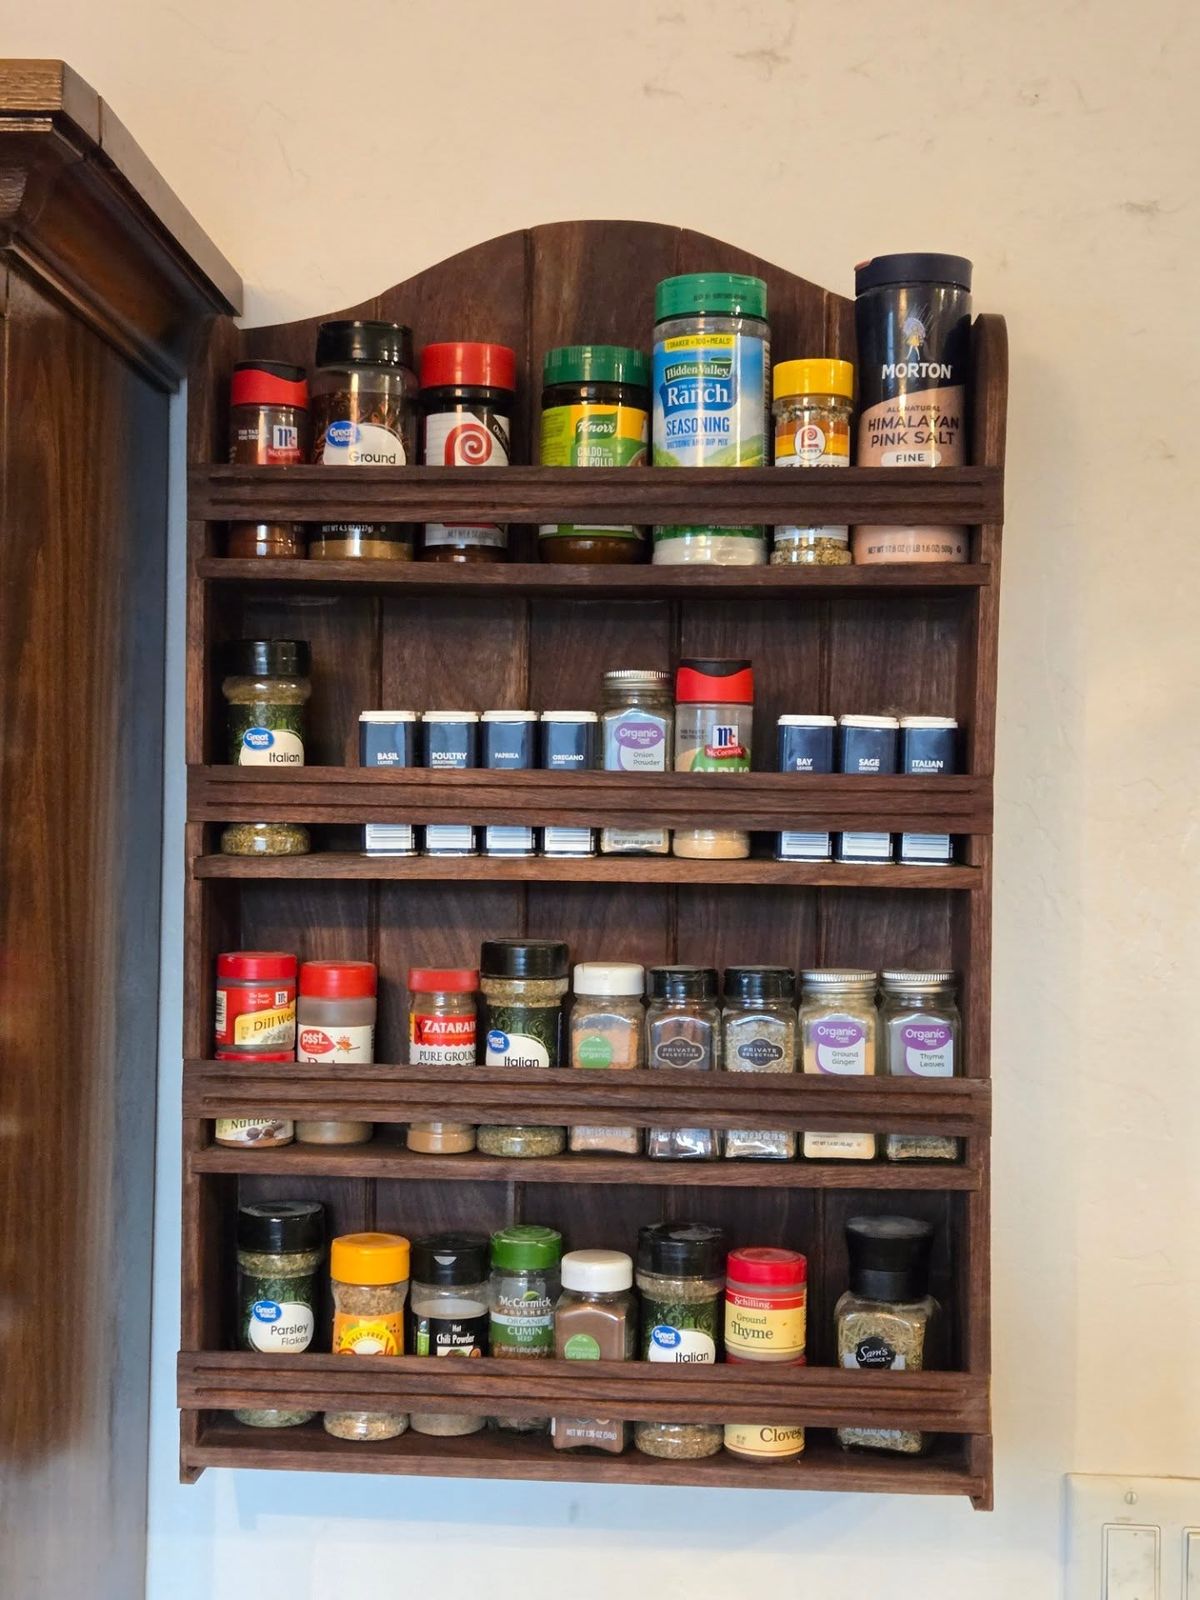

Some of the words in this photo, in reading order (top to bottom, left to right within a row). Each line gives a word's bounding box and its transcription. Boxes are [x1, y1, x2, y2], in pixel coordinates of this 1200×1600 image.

[666, 364, 697, 379] Hidden
[698, 363, 729, 377] Valley
[881, 362, 952, 380] MORTON
[667, 383, 729, 407] Ranch
[576, 421, 616, 434] Knorr
[666, 416, 730, 437] SEASONING
[868, 414, 960, 433] HIMALAYAN
[330, 427, 355, 437] Great
[871, 431, 908, 448] PINK
[914, 430, 955, 445] SALT
[349, 450, 397, 465] Ground
[589, 456, 614, 467] POLLO
[896, 453, 925, 463] FINE
[246, 732, 270, 742] Great
[619, 727, 659, 739] Organic
[269, 752, 301, 763] Italian
[377, 752, 400, 761] BASIL
[432, 752, 468, 761] POULTRY
[494, 752, 520, 760] PAPRIKA
[706, 747, 743, 757] McCormick
[796, 757, 813, 766] BAY
[858, 758, 880, 767] SAGE
[911, 760, 944, 769] ITALIAN
[253, 1016, 275, 1032] Dill
[817, 1026, 857, 1038] Organic
[905, 1028, 945, 1041] Organic
[419, 1050, 443, 1062] PURE
[831, 1050, 859, 1058] Ground
[920, 1053, 945, 1061] Thyme
[504, 1056, 540, 1067] Italian
[499, 1295, 552, 1308] McCormick
[734, 1295, 770, 1309] Schilling
[255, 1305, 276, 1314] Great
[503, 1308, 551, 1316] GOURMET
[506, 1317, 546, 1325] ORGANIC
[736, 1313, 768, 1325] Ground
[271, 1323, 309, 1336] Parsley
[452, 1324, 462, 1332] Hot
[507, 1326, 543, 1336] CUMIN
[730, 1320, 774, 1340] Thyme
[436, 1333, 451, 1345] Chili
[452, 1334, 475, 1344] Powder
[654, 1329, 676, 1340] Great
[281, 1335, 309, 1346] Flakes
[675, 1352, 710, 1363] Italian
[857, 1345, 889, 1362] Sam's
[566, 1428, 576, 1437] NET
[577, 1429, 585, 1438] WT
[759, 1427, 802, 1442] Cloves
